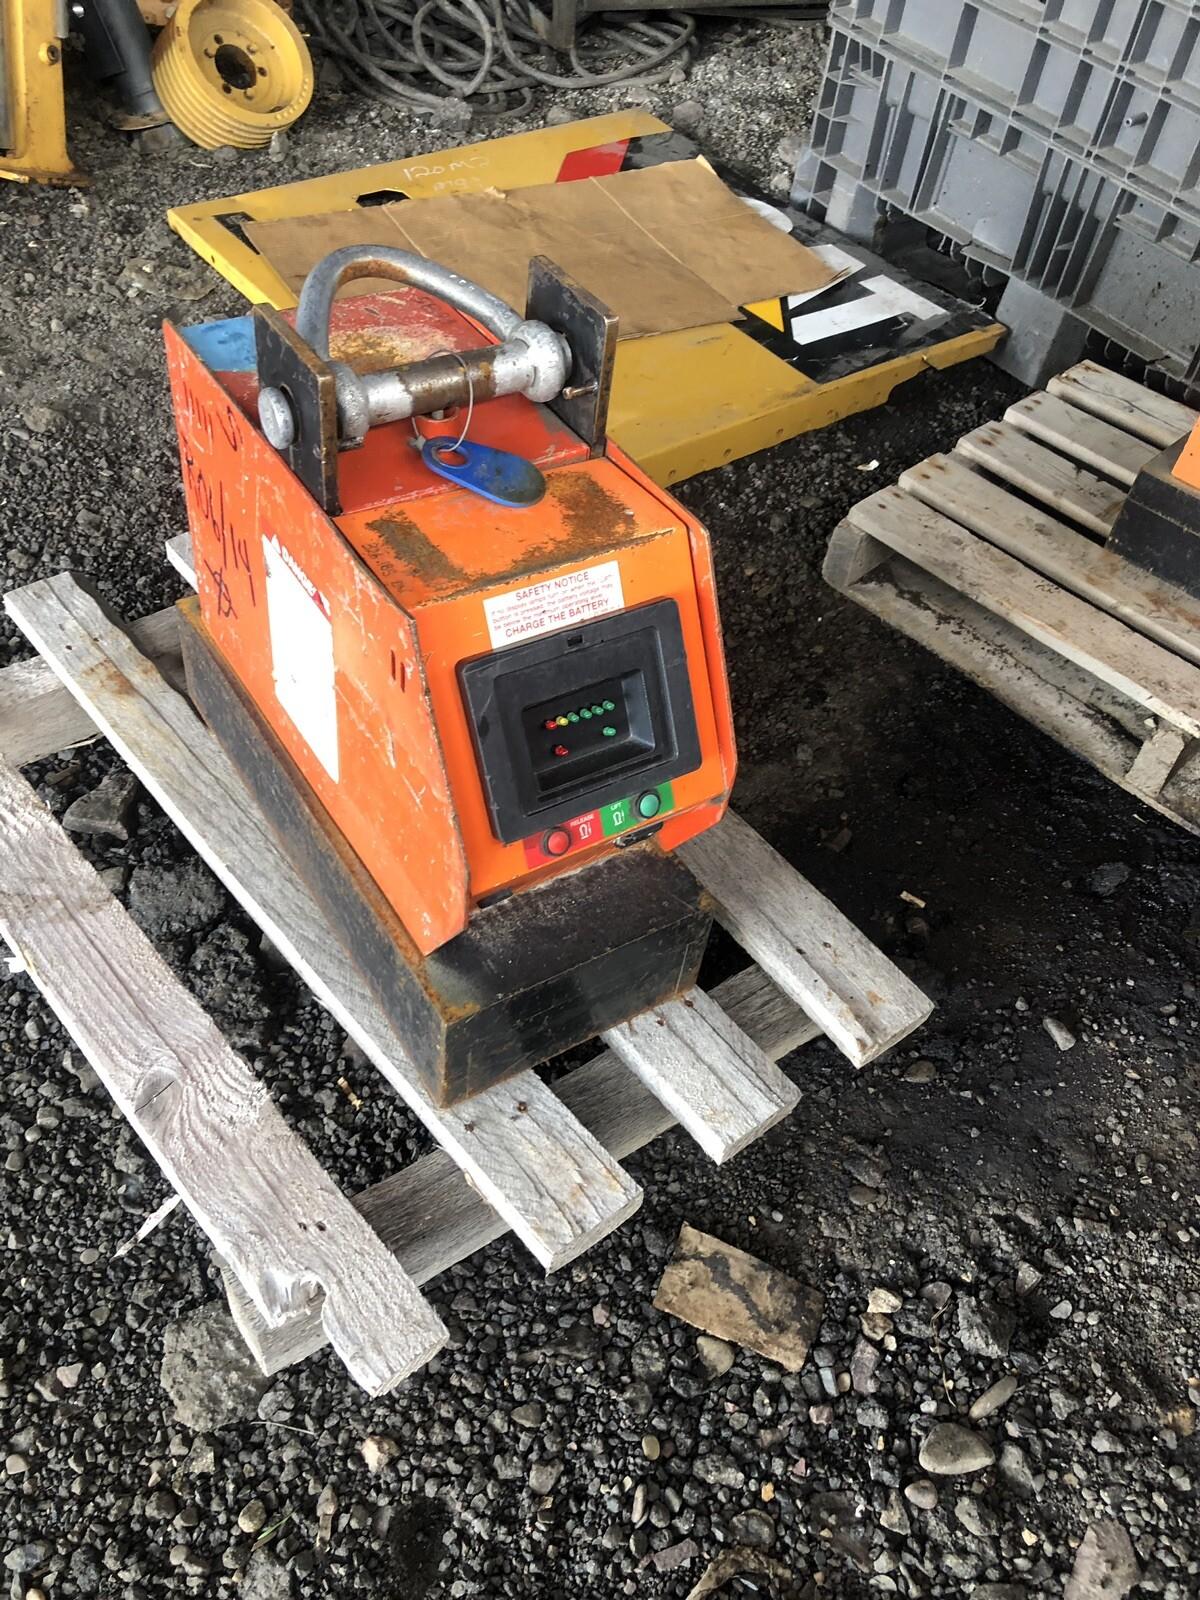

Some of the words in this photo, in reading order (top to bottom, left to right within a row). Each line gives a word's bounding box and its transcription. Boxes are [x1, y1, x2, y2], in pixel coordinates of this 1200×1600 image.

[515, 583, 551, 601] SAFETY
[554, 571, 589, 589] NOTICE
[505, 618, 546, 638] CHARGE
[548, 610, 566, 624] THE
[568, 598, 610, 617] BATTERY
[610, 801, 623, 811] LIFT
[569, 813, 595, 827] RELEASE
